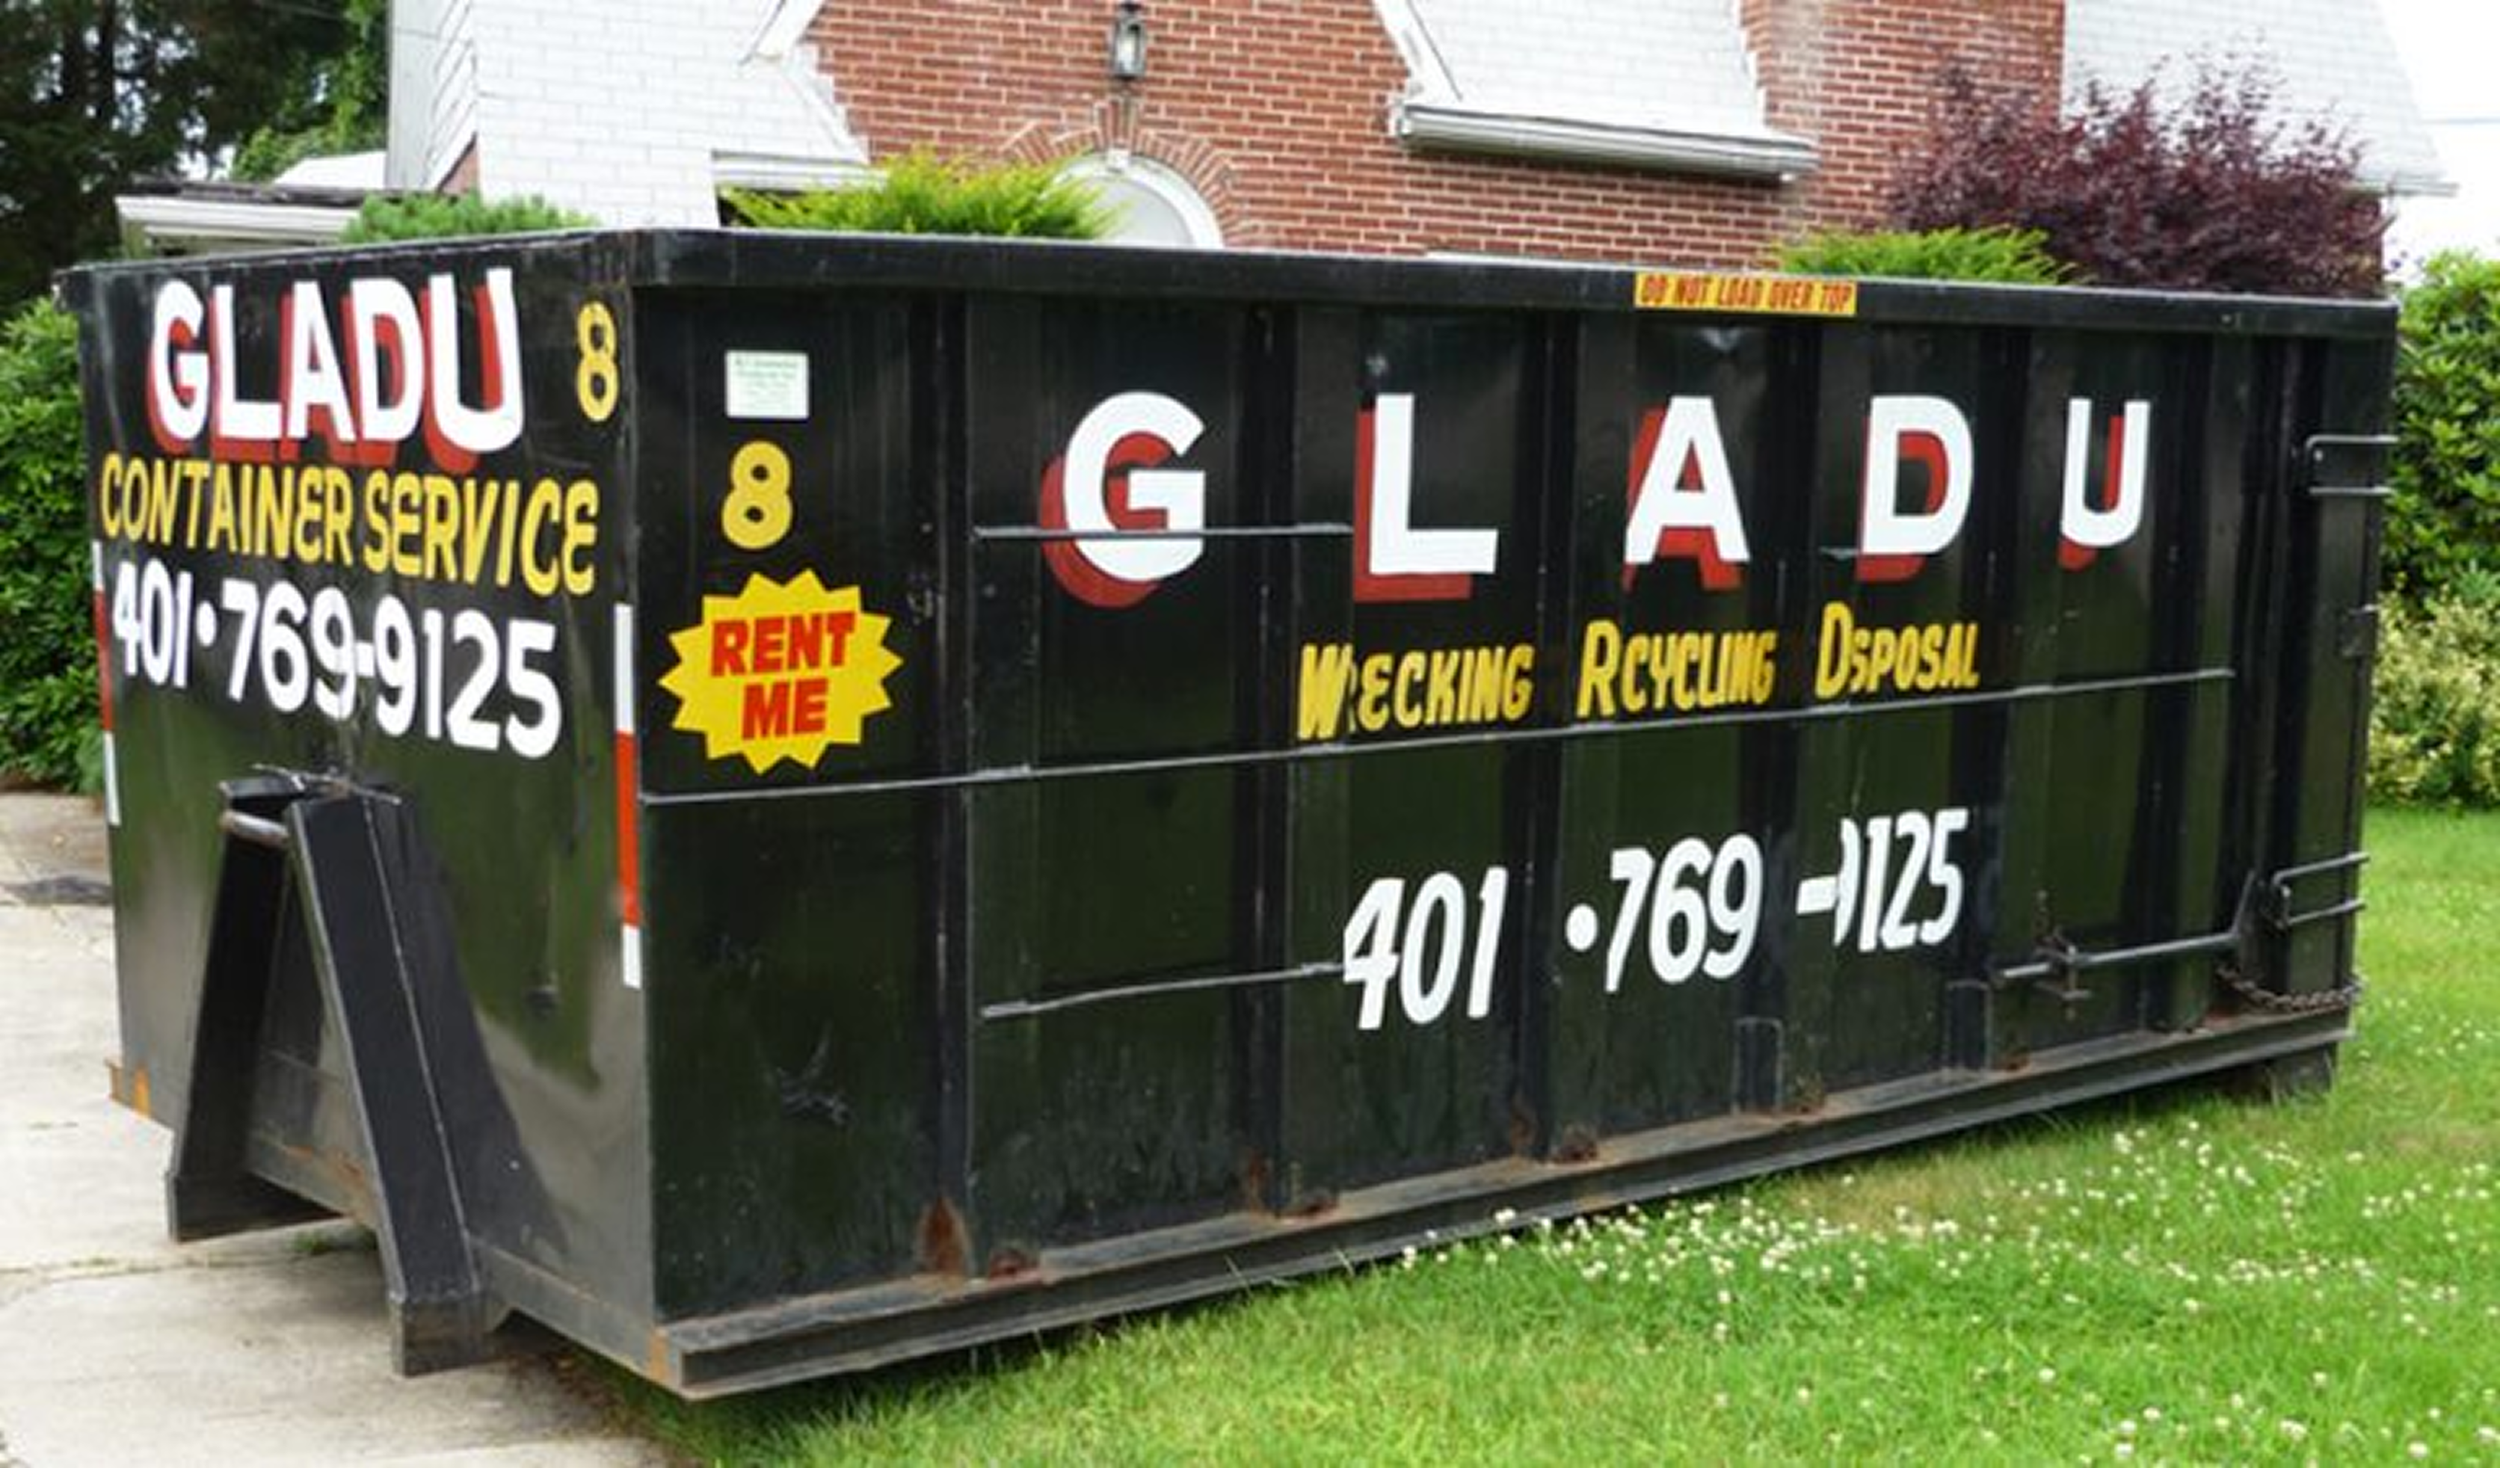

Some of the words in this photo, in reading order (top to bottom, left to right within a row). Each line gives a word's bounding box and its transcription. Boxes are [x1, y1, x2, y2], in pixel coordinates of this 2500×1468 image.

[1640, 275, 1668, 304] DO
[1674, 276, 1711, 305] NOT
[1717, 278, 1764, 308] LOAD
[1768, 280, 1813, 310] OVER
[1819, 283, 1853, 313] TOP
[148, 268, 525, 472] GLADU
[576, 300, 619, 422] 8
[102, 453, 353, 566] CONTAINER
[361, 468, 599, 596] SERVICE
[721, 440, 793, 550] 8
[710, 611, 857, 677] RENT
[741, 678, 829, 741] ME
